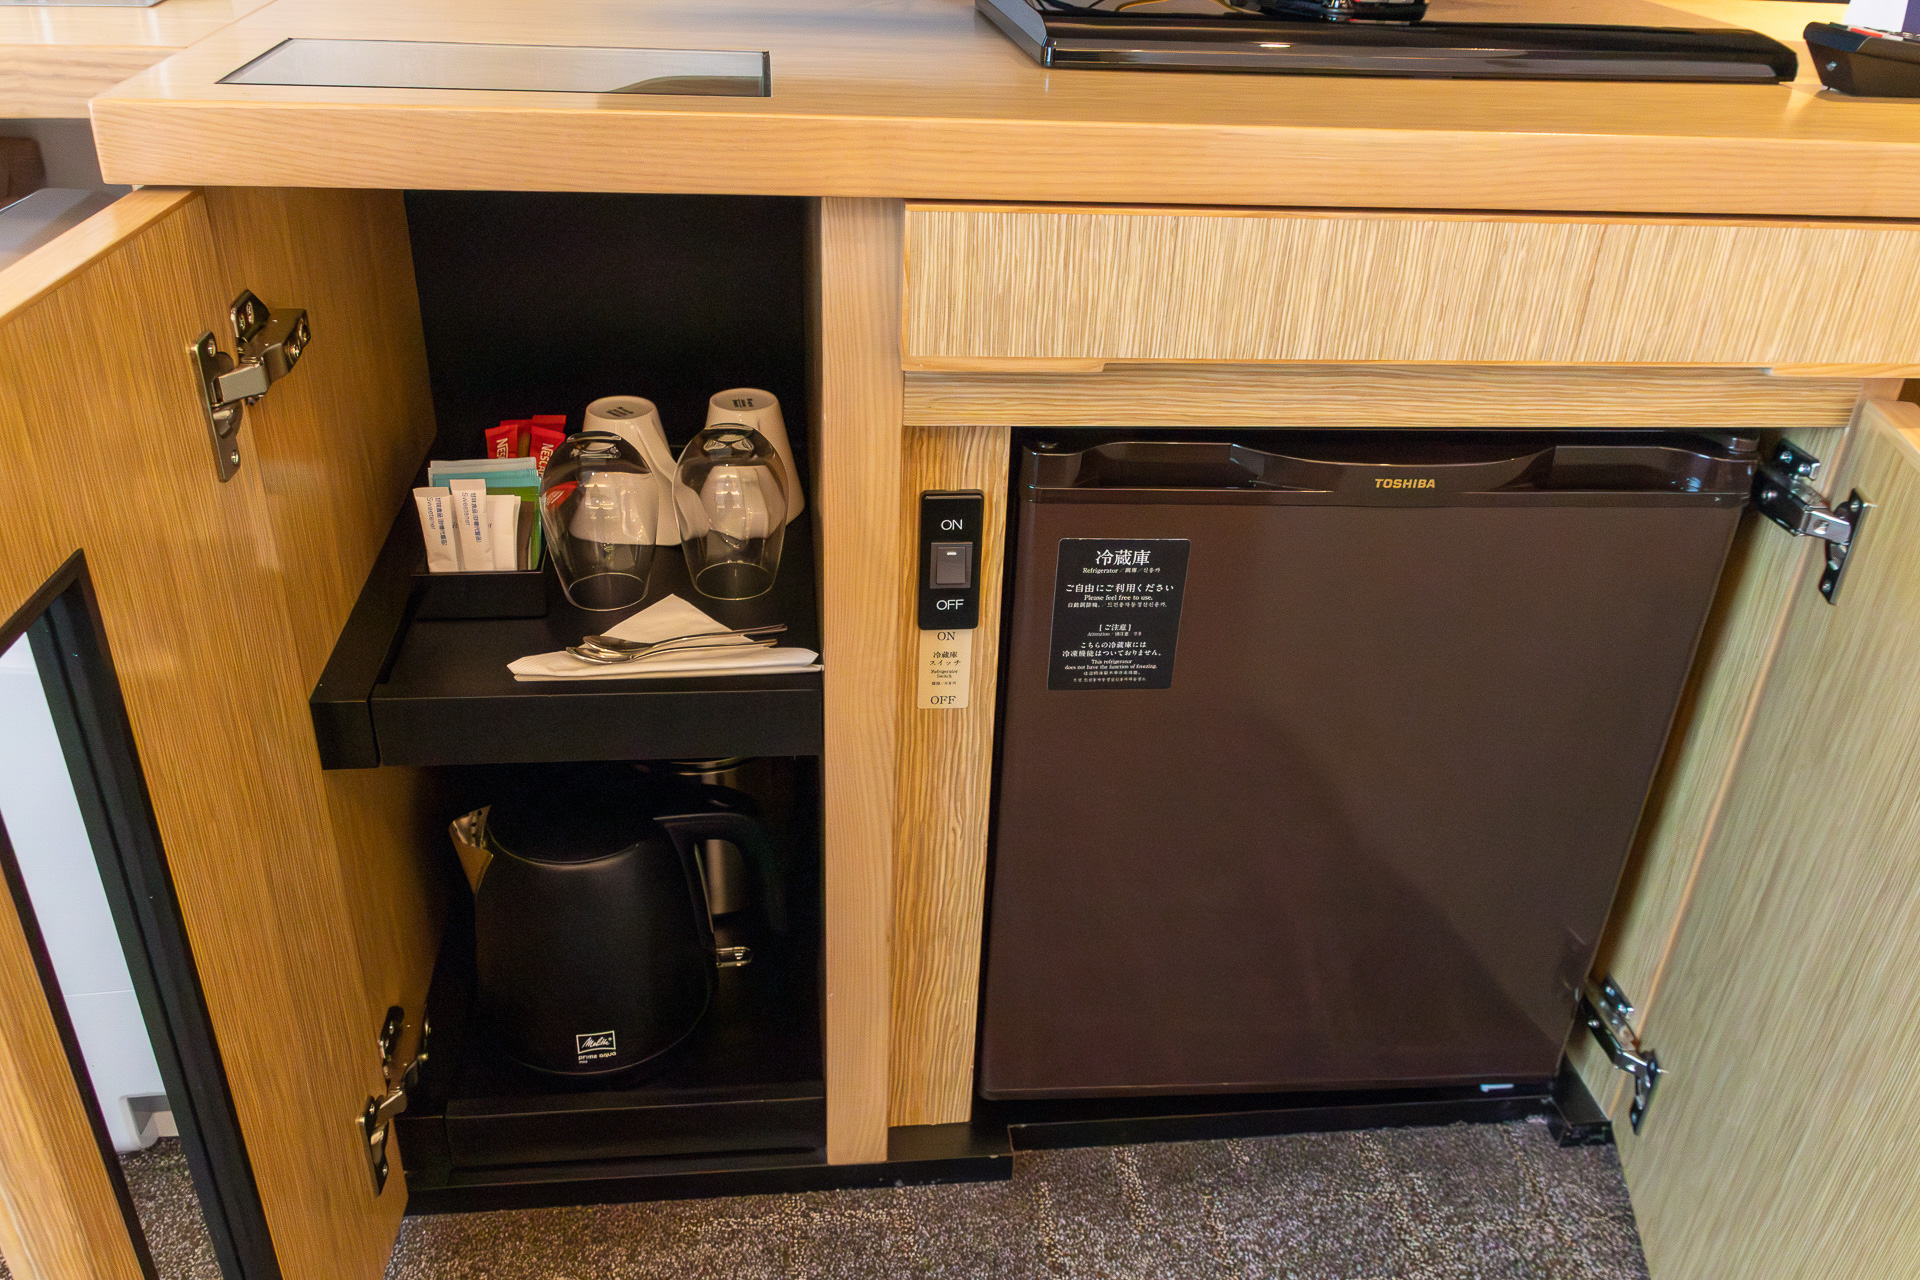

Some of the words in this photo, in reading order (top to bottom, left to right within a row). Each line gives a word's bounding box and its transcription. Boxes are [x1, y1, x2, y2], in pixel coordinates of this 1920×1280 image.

[1375, 479, 1435, 489] TOSHIBA
[940, 519, 963, 531] ON
[1095, 549, 1151, 566] 冷蔵庫
[1065, 583, 1175, 593] ご自由にご利用ください
[936, 599, 964, 610] OFF
[937, 631, 956, 641] ON
[1081, 641, 1147, 649] こちらの冷蔵庫には
[930, 696, 957, 705] OFF
